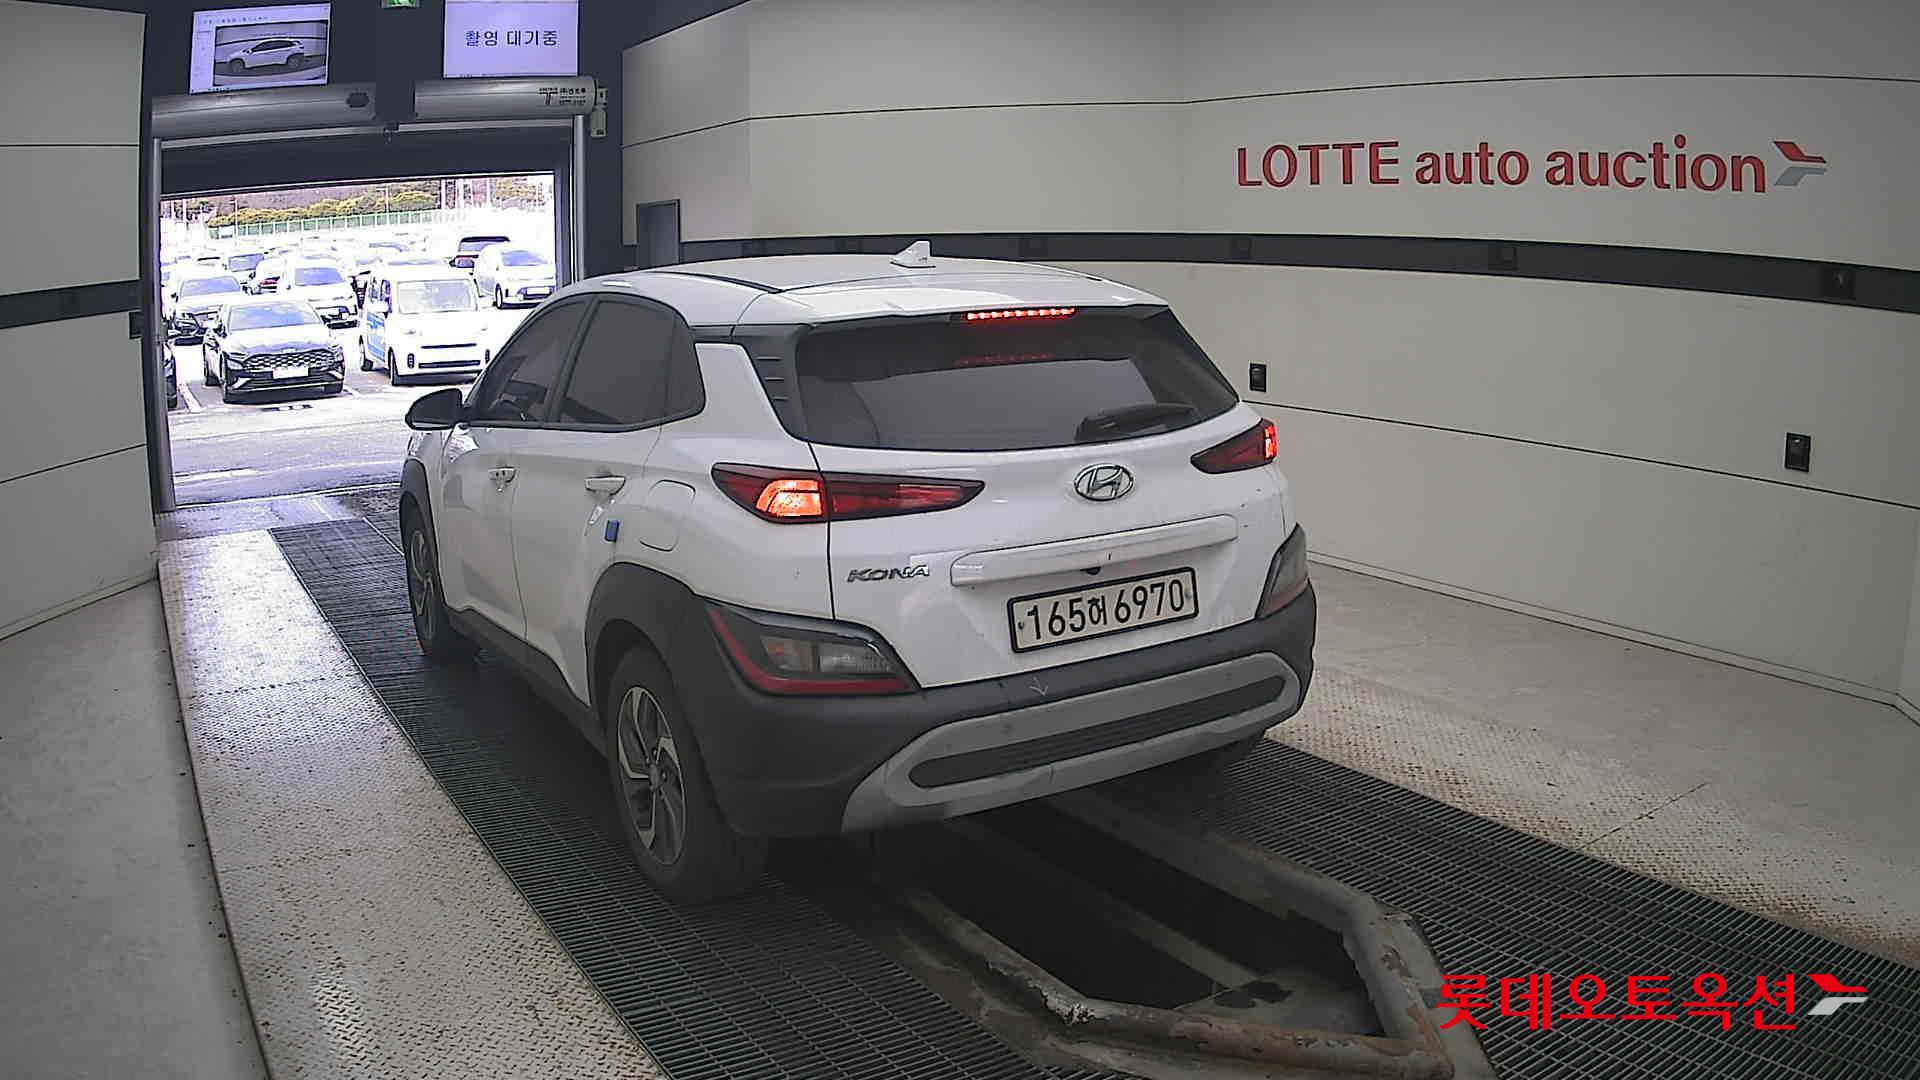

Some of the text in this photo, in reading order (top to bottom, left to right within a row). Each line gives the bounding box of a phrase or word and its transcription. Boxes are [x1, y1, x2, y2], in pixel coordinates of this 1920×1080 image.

[466, 30, 558, 47] 촬영 대기중
[1237, 134, 1766, 193] LOTTE auto auction
[847, 564, 930, 582] KONA
[1027, 579, 1185, 640] 165허6970
